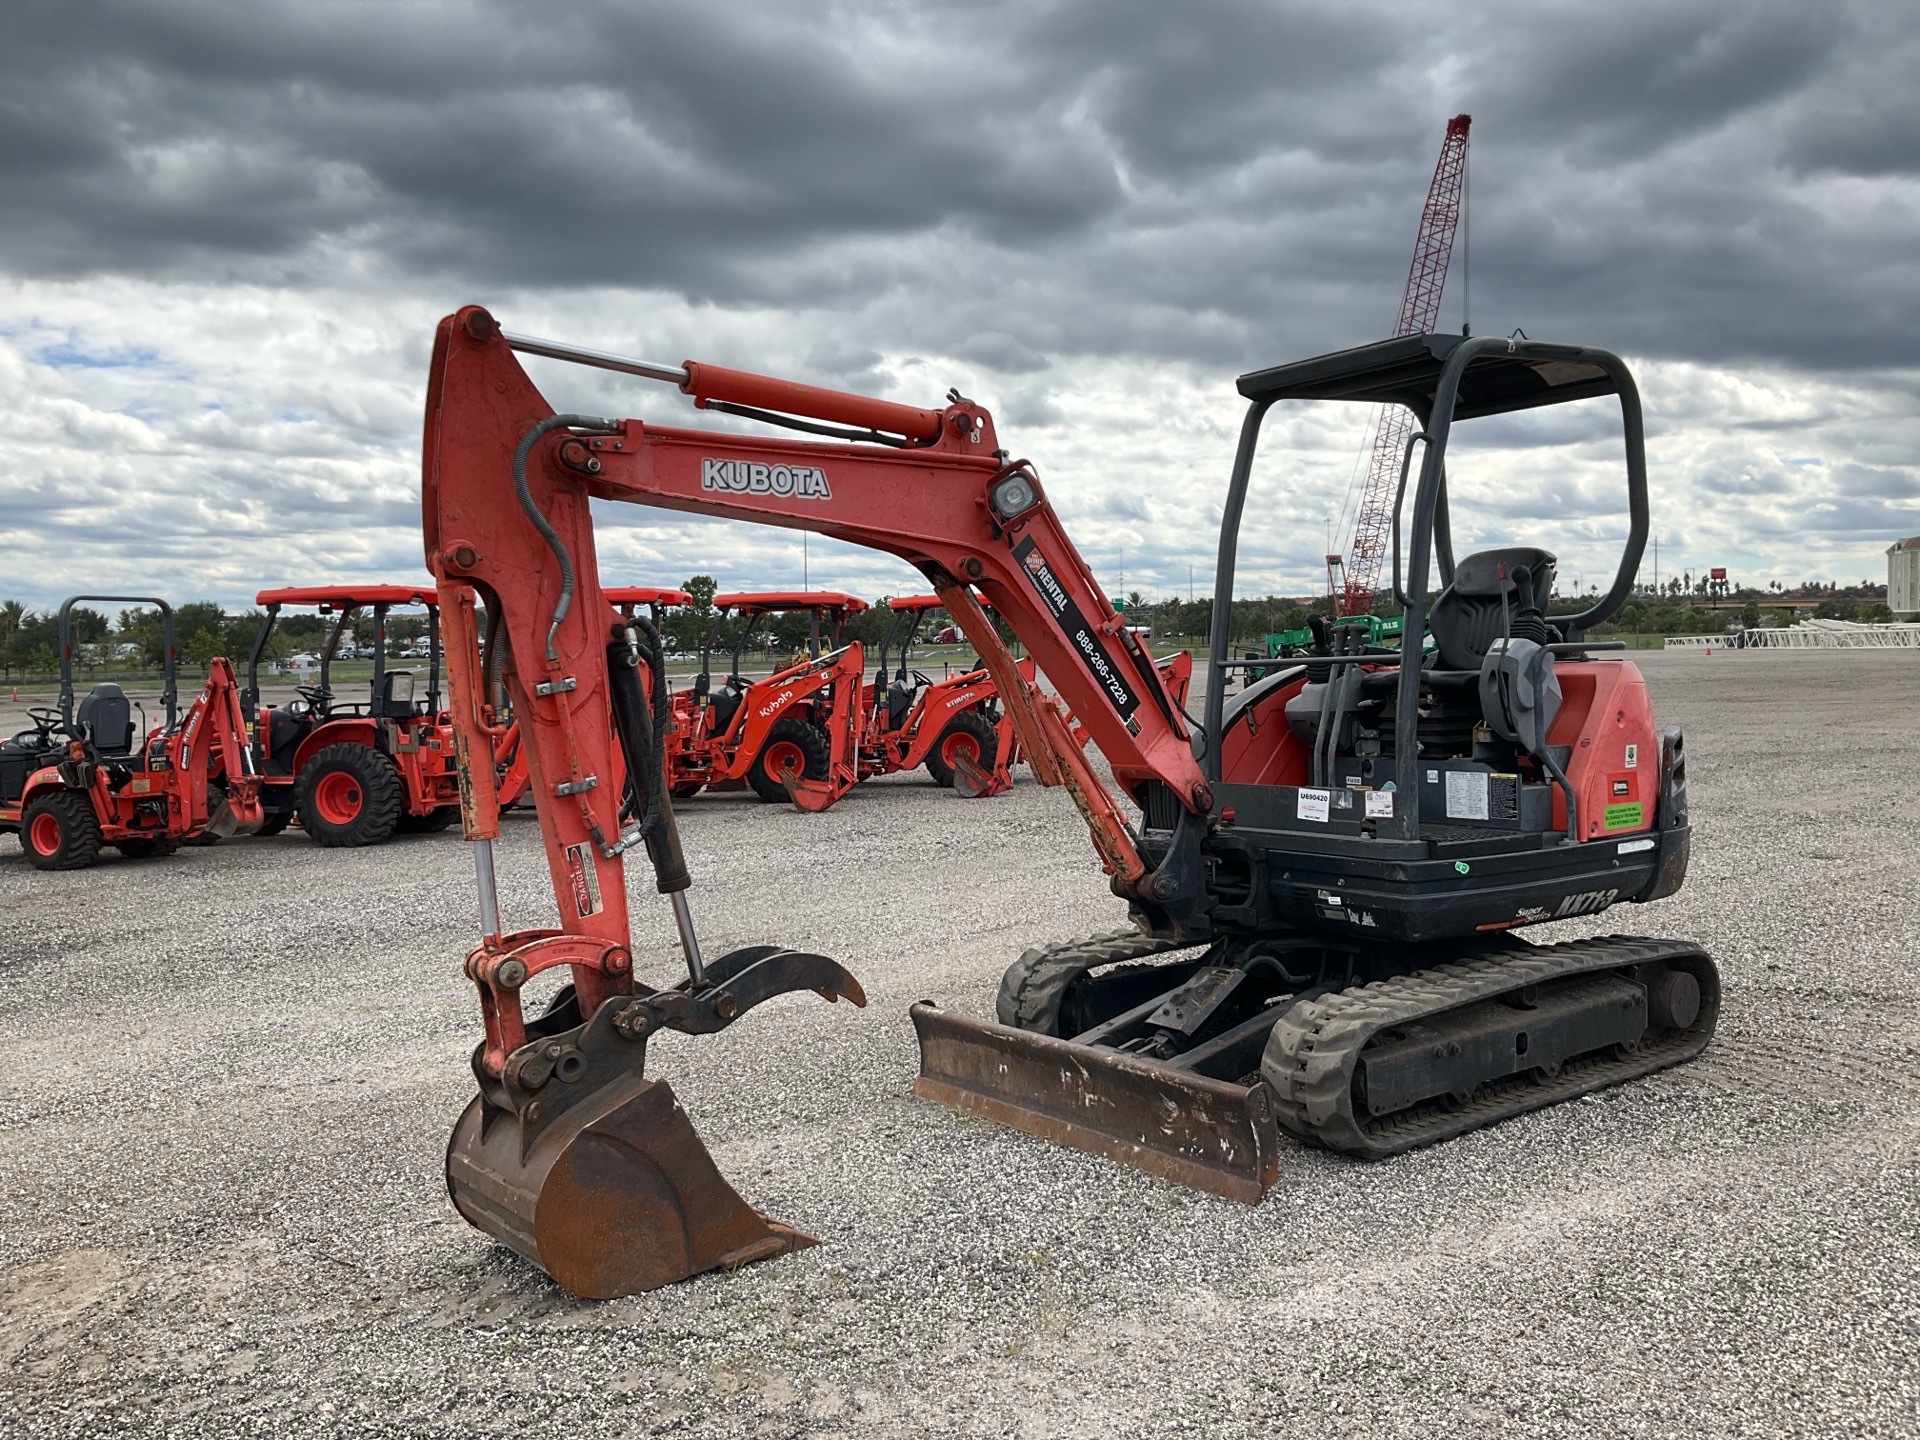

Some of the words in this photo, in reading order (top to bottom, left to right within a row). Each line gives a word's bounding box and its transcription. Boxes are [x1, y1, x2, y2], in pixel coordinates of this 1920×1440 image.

[702, 458, 831, 499] KUBOTA
[1037, 565, 1068, 611] RENTAL
[1076, 630, 1128, 705] 888-266-7228
[759, 690, 793, 717] Kubota
[946, 692, 976, 708] KUBOTA
[183, 711, 200, 742] KUBOTA
[1300, 792, 1328, 802] U690420
[1515, 906, 1544, 917] Super
[1526, 911, 1552, 922] Series
[1554, 888, 1619, 917] KX71-3
